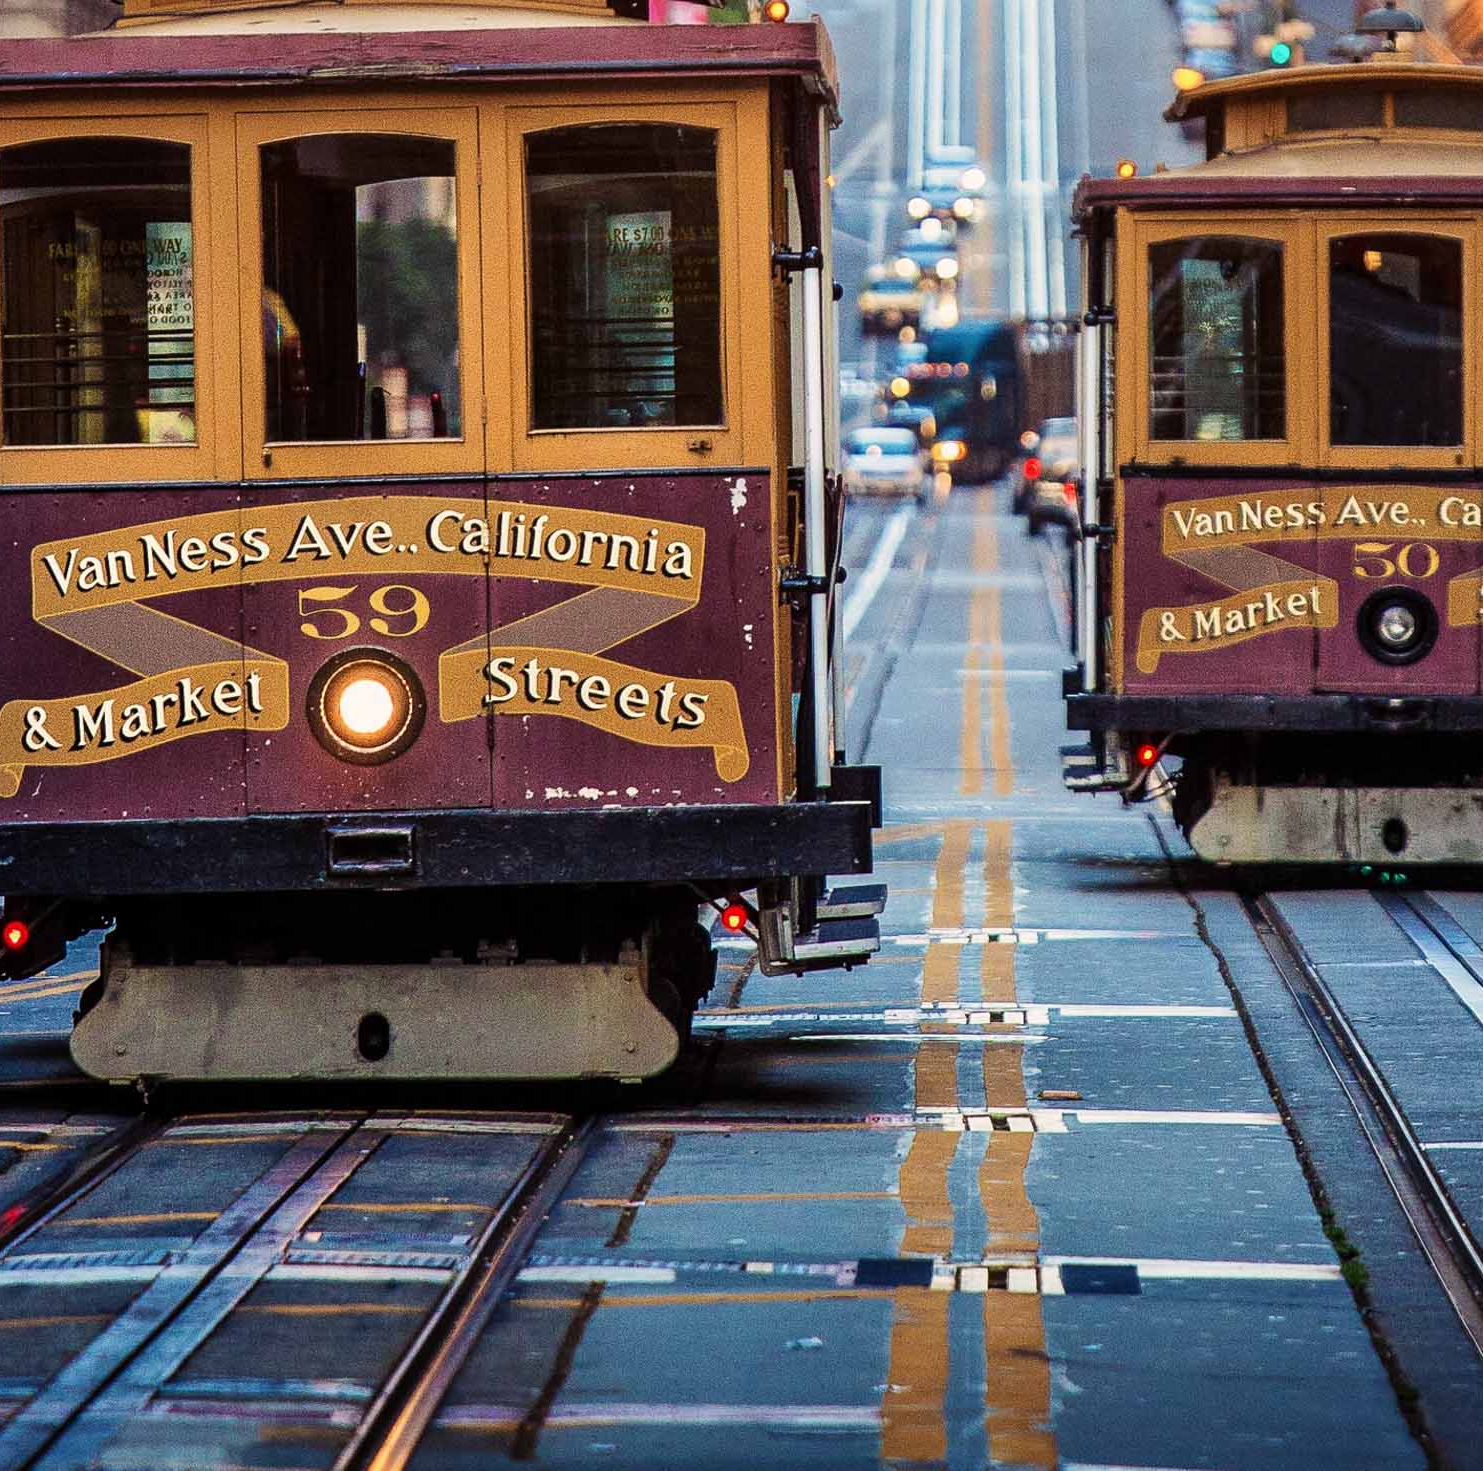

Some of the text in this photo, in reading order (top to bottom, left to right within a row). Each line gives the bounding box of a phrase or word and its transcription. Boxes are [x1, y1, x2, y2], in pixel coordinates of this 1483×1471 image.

[1173, 507, 1234, 539] Van
[1237, 500, 1326, 531] Ness
[43, 548, 137, 597] Van
[140, 528, 269, 581] Ness
[427, 509, 694, 579] California
[1352, 542, 1440, 578] 50
[298, 584, 430, 639] 59
[1160, 586, 1322, 641] & Market
[22, 671, 264, 752] & Market
[483, 656, 710, 731] Streets
